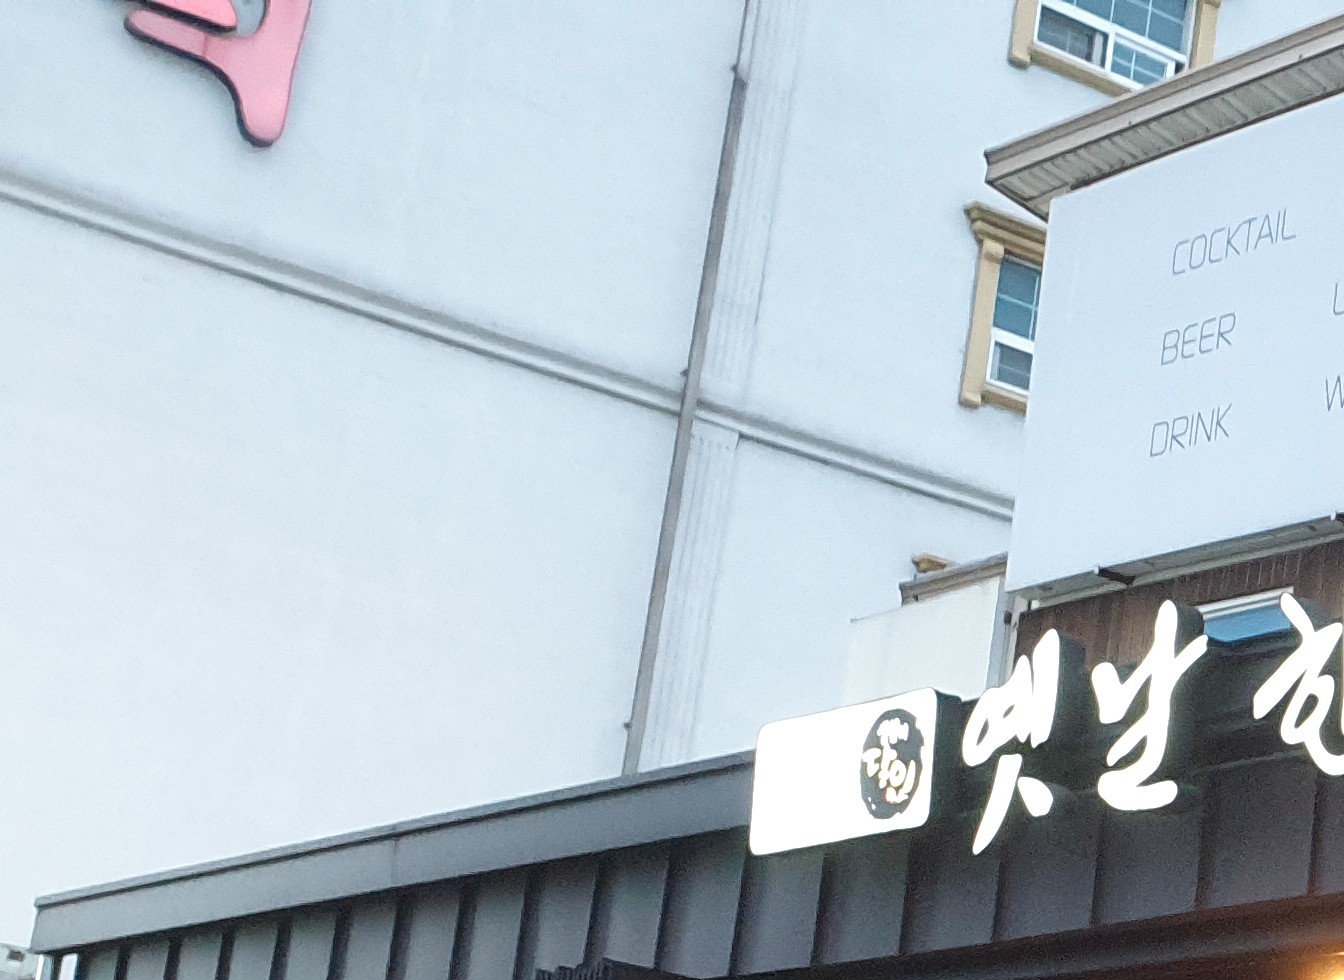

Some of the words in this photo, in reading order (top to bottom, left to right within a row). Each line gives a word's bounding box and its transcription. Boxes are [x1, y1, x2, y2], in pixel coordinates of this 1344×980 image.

[1172, 208, 1297, 276] COCKTAIL
[1160, 312, 1236, 366] BEER
[1149, 403, 1232, 457] DRINK
[961, 600, 1208, 855] 옛날
